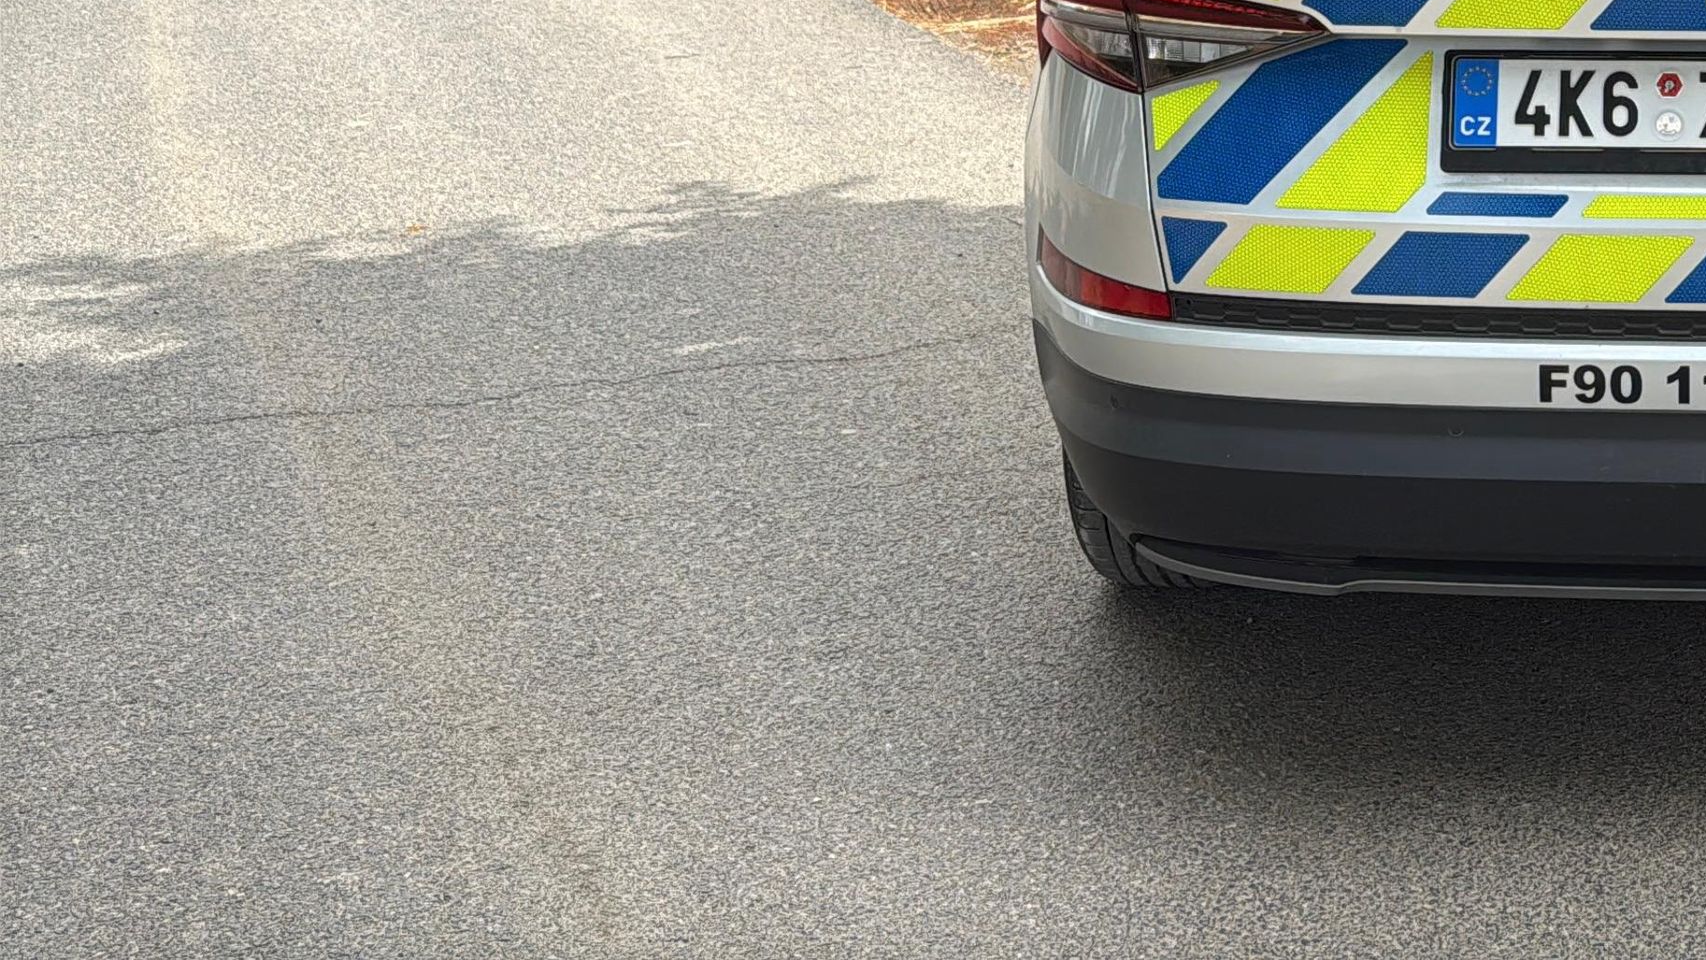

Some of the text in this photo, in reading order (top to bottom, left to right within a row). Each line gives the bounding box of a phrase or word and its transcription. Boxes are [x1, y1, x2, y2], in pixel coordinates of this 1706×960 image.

[1514, 69, 1640, 137] 4K6
[1460, 115, 1492, 136] CZ
[1538, 364, 1643, 404] F90
